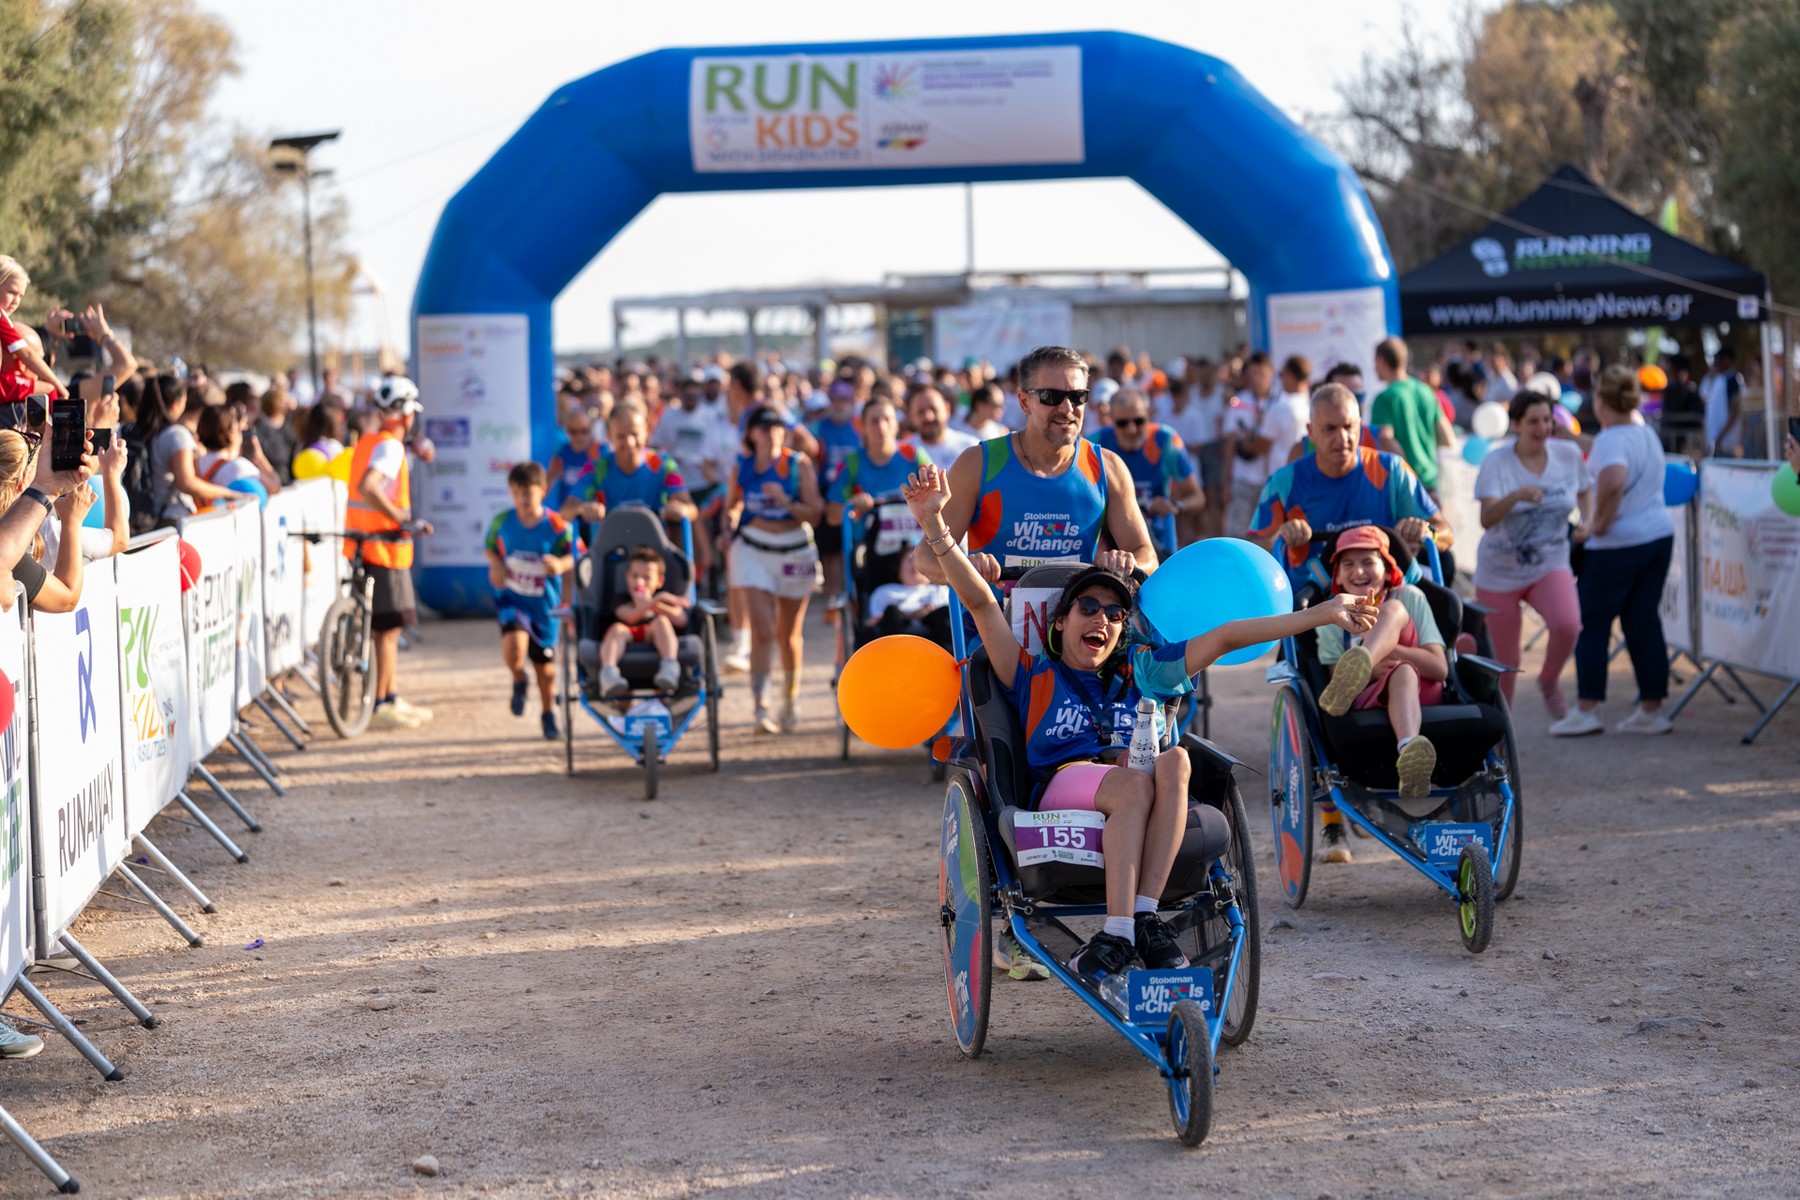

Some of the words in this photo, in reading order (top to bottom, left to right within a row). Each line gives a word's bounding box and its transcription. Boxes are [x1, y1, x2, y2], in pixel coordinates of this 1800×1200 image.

[706, 61, 858, 113] RUN
[756, 112, 860, 148] KIDS
[1515, 233, 1652, 258] RUNNING
[1428, 292, 1693, 326] www.RunningNews.gr
[1024, 512, 1070, 520] Stoiximan
[1014, 521, 1080, 537] Wheels
[1006, 538, 1018, 547] of
[1016, 535, 1083, 554] Change
[1021, 559, 1046, 568] RUN
[58, 758, 114, 877] RUNAWAY
[1033, 812, 1060, 820] RUN
[1040, 827, 1086, 848] 155
[1435, 835, 1484, 846] Wheels
[1149, 976, 1193, 985] Stoiximan
[1141, 984, 1204, 1000] Wheels
[1135, 1003, 1146, 1012] of
[1145, 999, 1211, 1013] Chae
